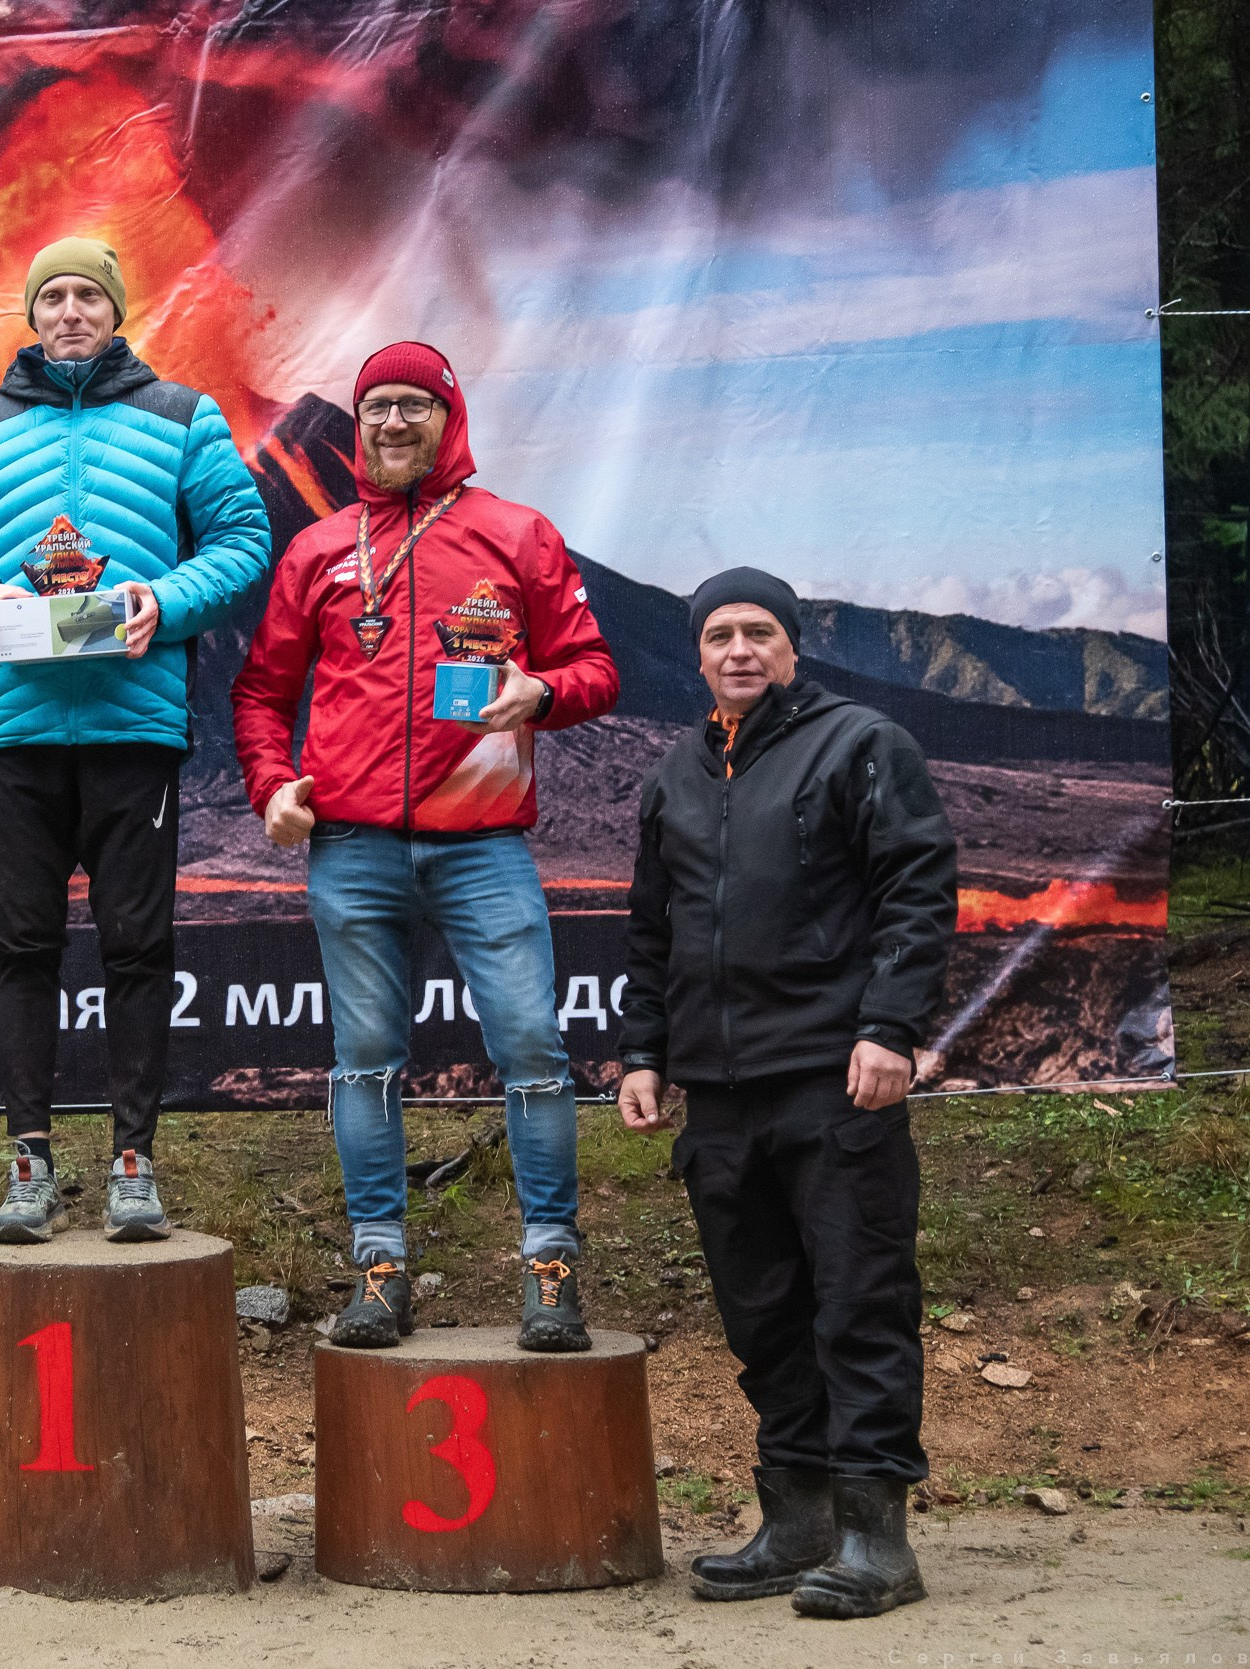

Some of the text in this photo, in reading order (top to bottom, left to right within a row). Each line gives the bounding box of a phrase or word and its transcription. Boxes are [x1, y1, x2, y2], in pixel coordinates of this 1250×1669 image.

[47, 531, 77, 542] ТРЕЙЛ
[34, 538, 92, 552] УРАЛЬСКИЙ
[42, 571, 88, 584] 1 МЕСТО
[466, 598, 498, 608] ТРЕЙЛ
[451, 606, 511, 619] УРАЛЬСКИЙ
[453, 638, 502, 651] 3 МЕСТО
[225, 982, 324, 1027] мл
[17, 1321, 95, 1472] 1
[401, 1374, 496, 1532] 3
